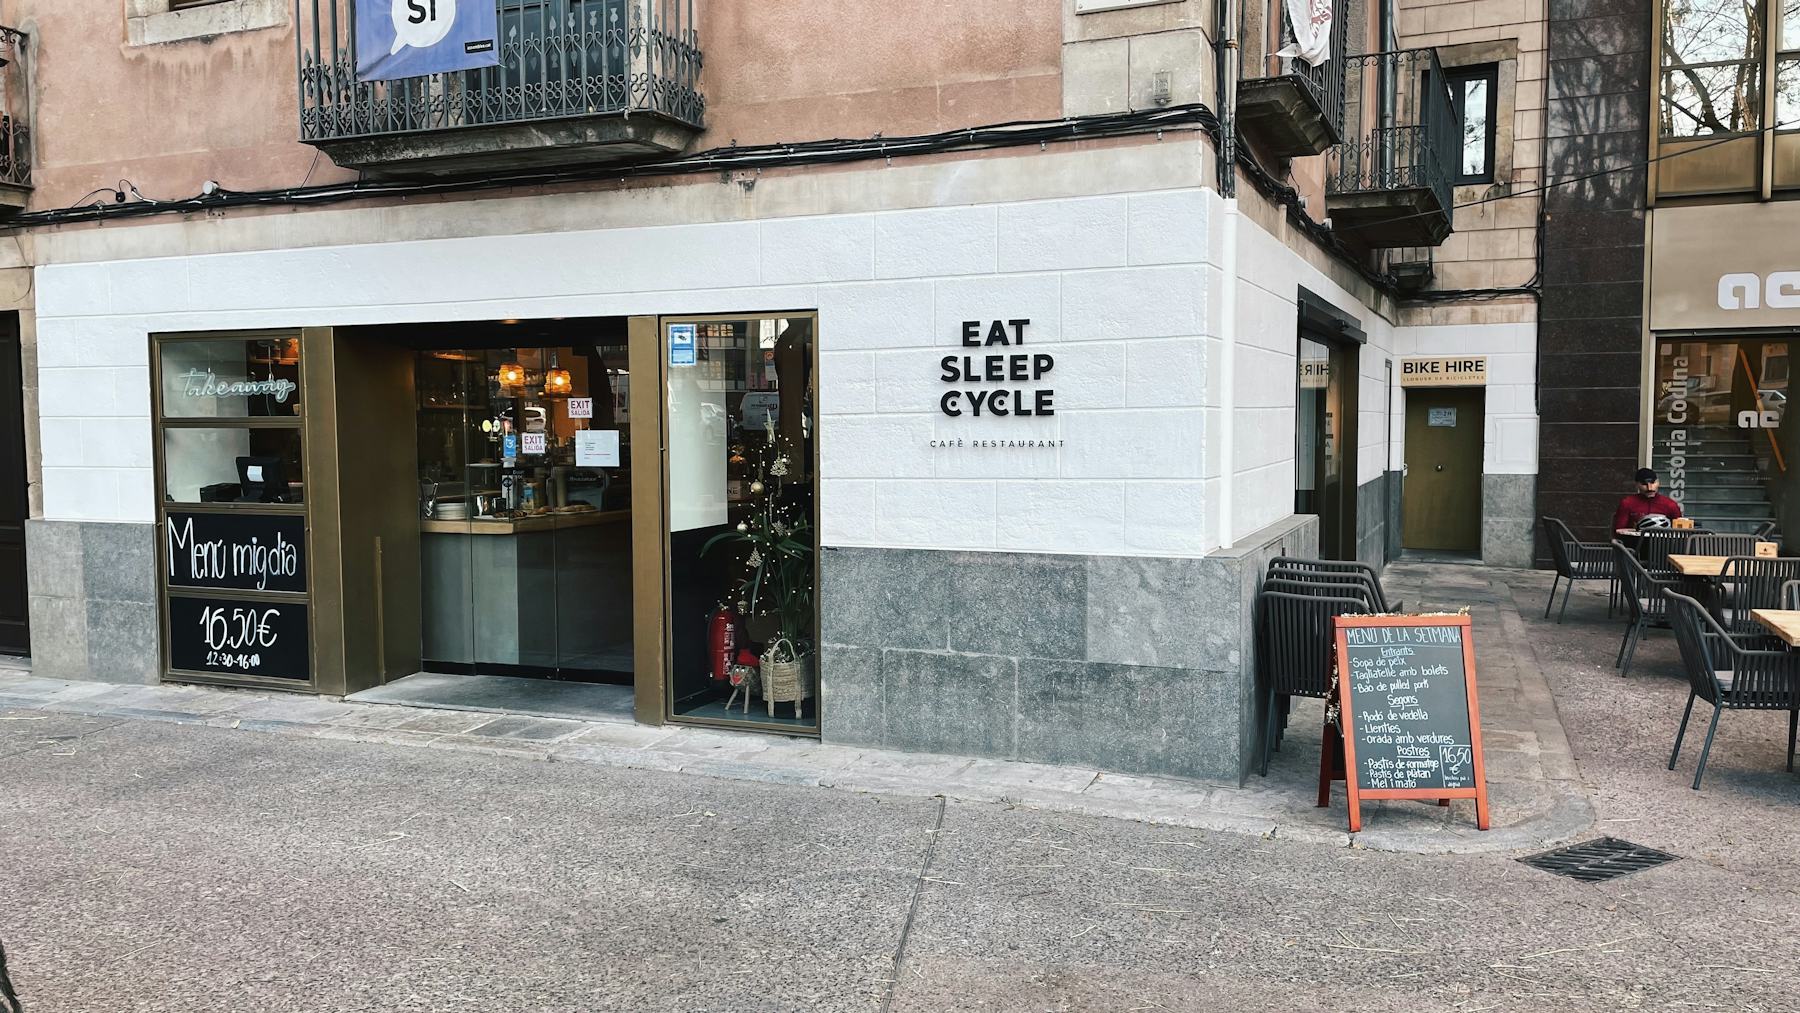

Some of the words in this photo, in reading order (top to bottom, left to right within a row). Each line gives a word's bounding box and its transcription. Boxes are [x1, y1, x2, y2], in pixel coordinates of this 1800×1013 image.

[962, 319, 1030, 347] EAT
[940, 354, 1054, 382] SLEEP
[1403, 361, 1440, 374] BIKE
[1445, 360, 1484, 373] HIRE
[1667, 356, 1689, 424] Codina
[570, 400, 590, 409] EXIT
[940, 389, 1054, 417] CYCLE
[1737, 410, 1780, 428] ac
[524, 435, 542, 444] EXIT
[972, 440, 1065, 448] RESTAURANT
[167, 516, 226, 579] Menú
[1382, 627, 1395, 643] DE
[1396, 627, 1410, 642] LA
[1414, 626, 1461, 643] SETMANA
[1376, 656, 1386, 666] de
[1399, 667, 1417, 677] amb
[1421, 663, 1449, 676] bolets
[1376, 681, 1387, 692] de
[1390, 679, 1410, 694] pulled
[1387, 694, 1418, 709] Segons
[1387, 709, 1398, 720] de
[1399, 708, 1429, 720] vedella
[1395, 731, 1415, 744] amb
[1416, 731, 1455, 745] verdures
[1396, 744, 1431, 756] Postres
[1395, 758, 1406, 769] de
[1406, 758, 1439, 772] formatge
[1393, 768, 1404, 779] de
